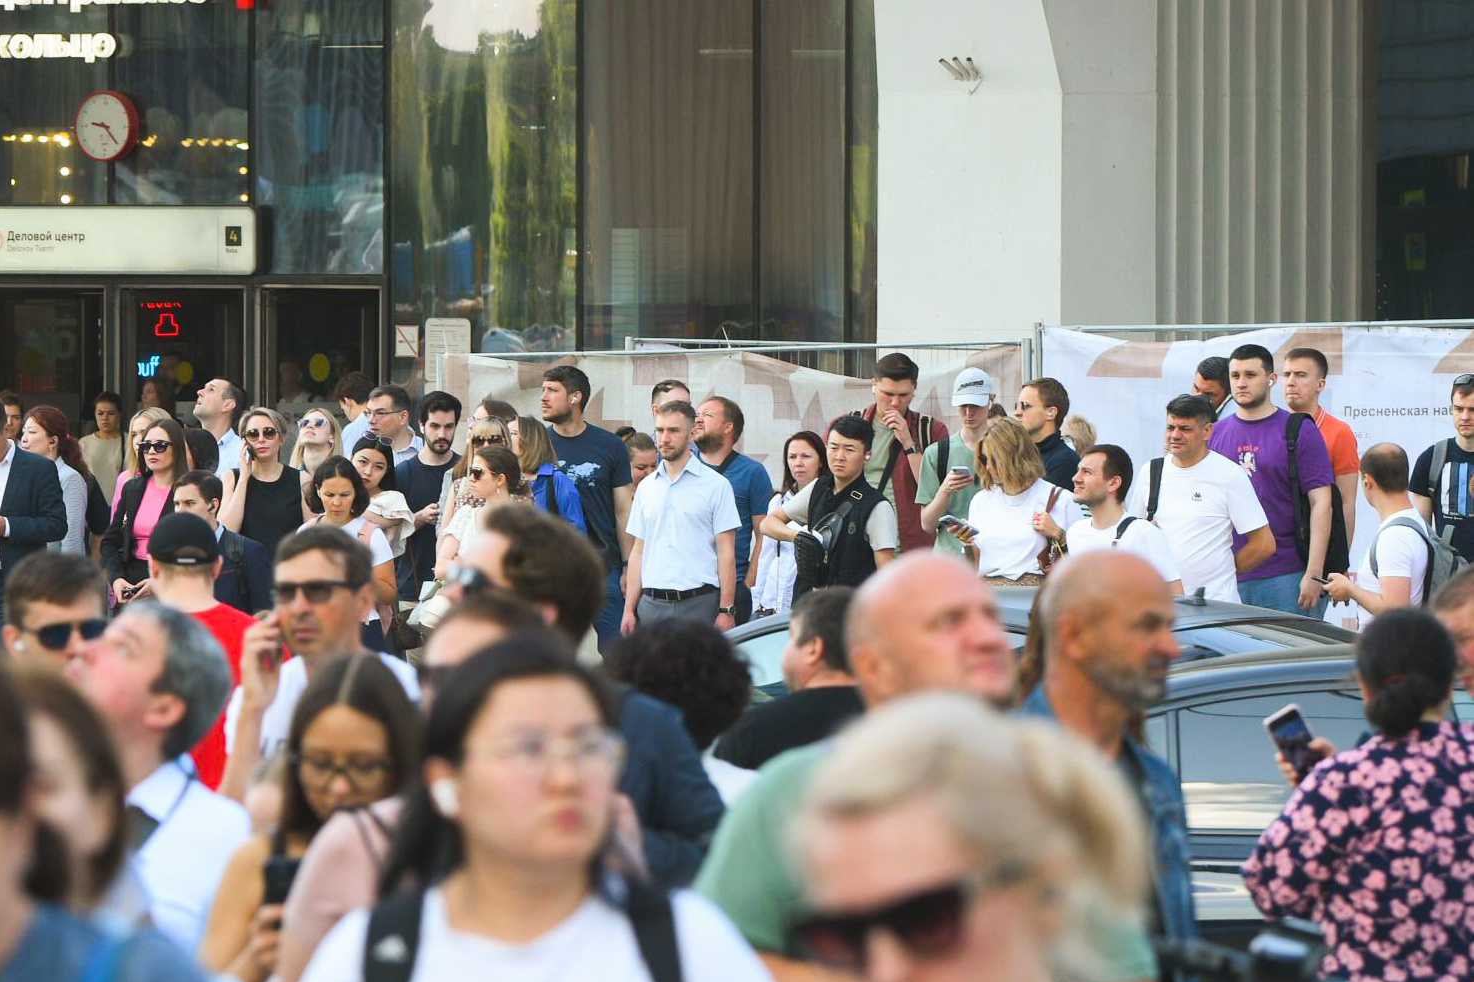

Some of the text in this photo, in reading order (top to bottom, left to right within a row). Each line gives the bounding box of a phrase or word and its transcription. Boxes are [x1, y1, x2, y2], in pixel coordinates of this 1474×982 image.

[6, 230, 52, 243] Деловой
[54, 234, 86, 244] центр
[229, 229, 238, 243] 4
[1344, 405, 1429, 419] Пресненская
